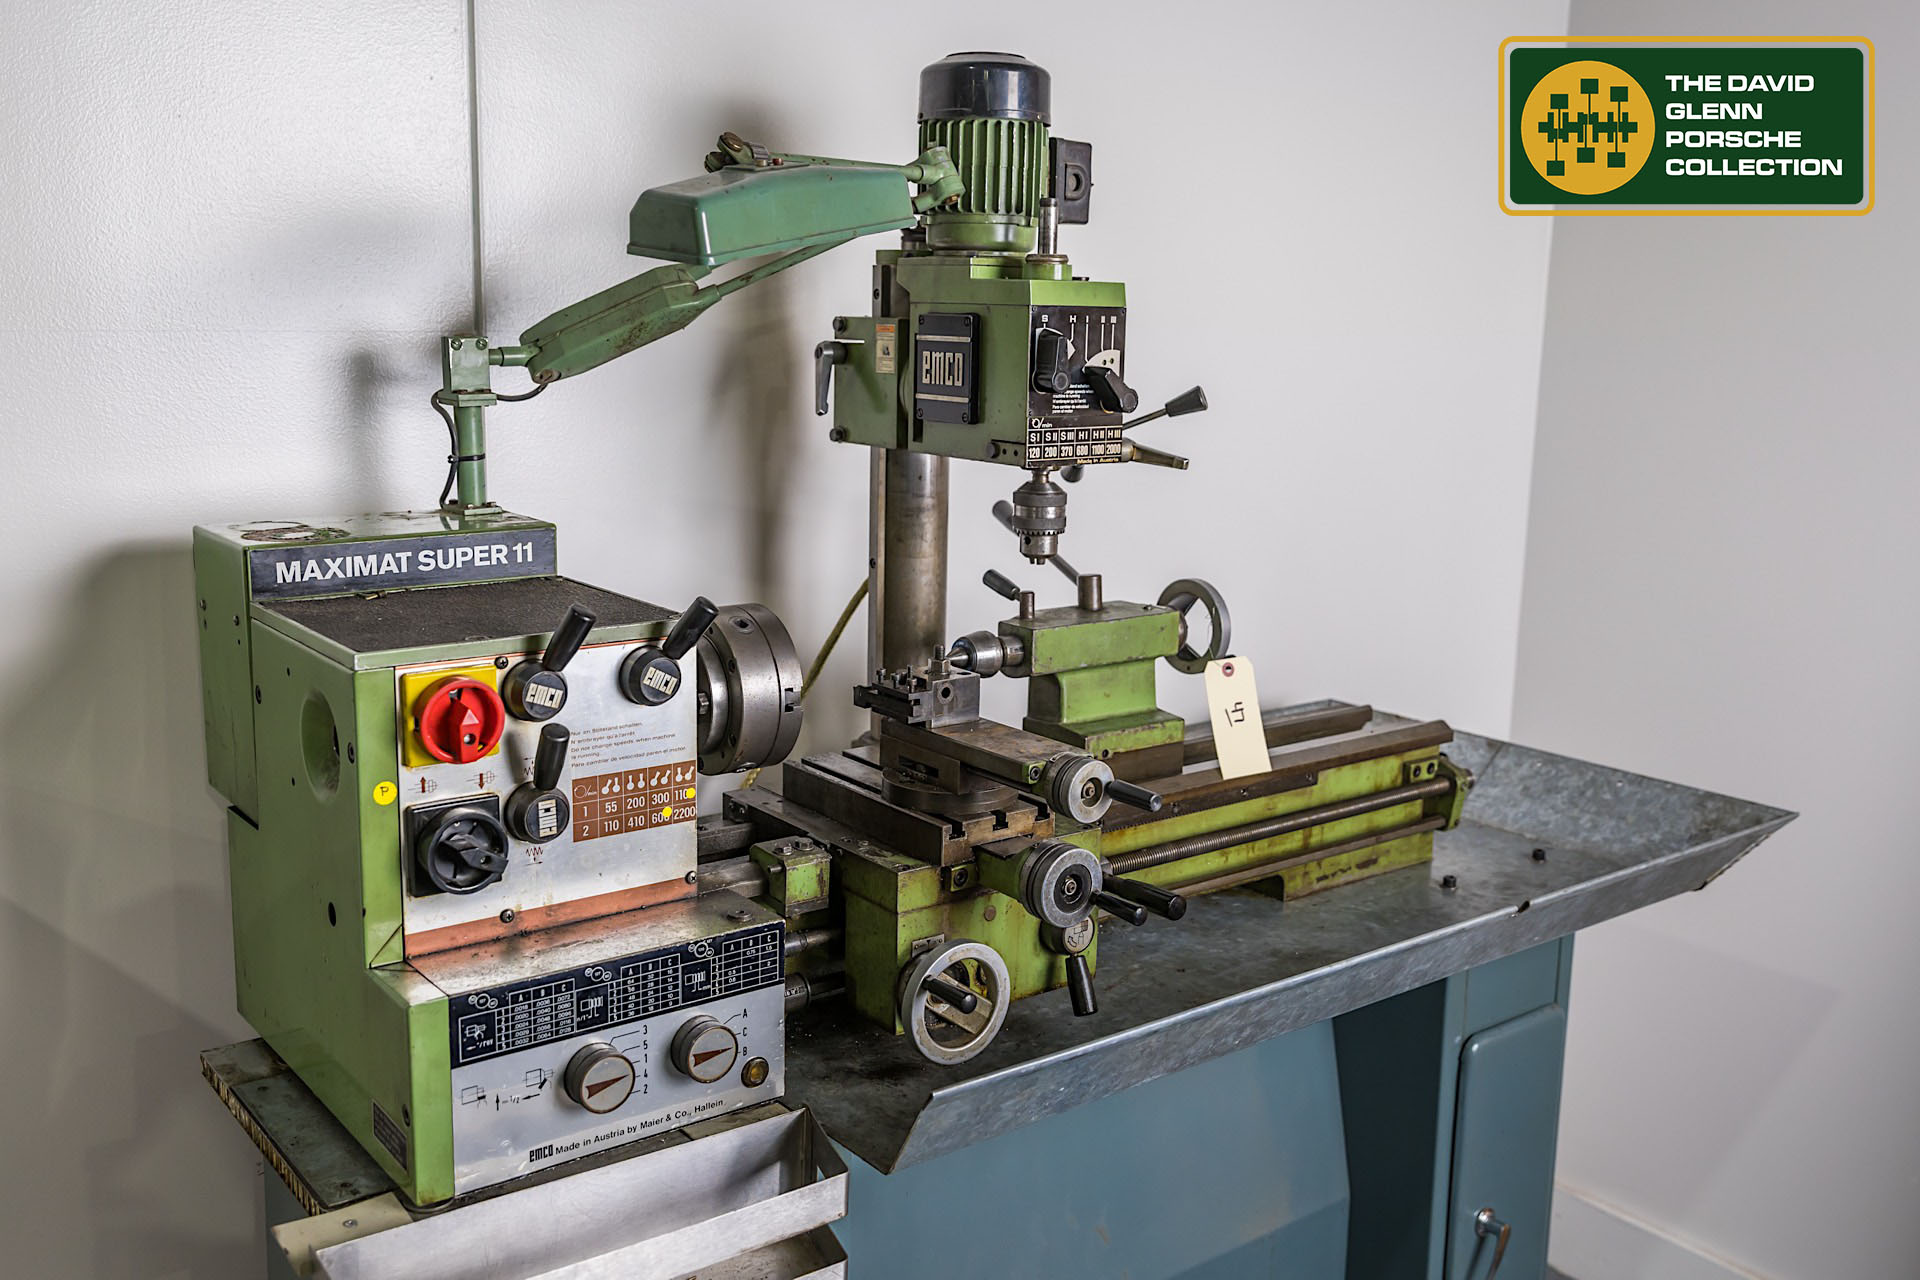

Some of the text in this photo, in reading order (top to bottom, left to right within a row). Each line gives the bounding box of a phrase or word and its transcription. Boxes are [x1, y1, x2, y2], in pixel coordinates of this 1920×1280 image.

[1042, 314, 1048, 322] S
[1070, 315, 1076, 323] H
[922, 350, 964, 387] emco
[1029, 448, 1040, 458] 120
[1044, 446, 1057, 457] 200
[1061, 446, 1073, 456] 370
[276, 542, 533, 584] MAXIMAT SUPER 11
[642, 666, 678, 695] emco
[525, 682, 564, 709] emco
[380, 786, 389, 796] P
[583, 806, 588, 817] 1
[605, 801, 617, 813] 55
[627, 796, 645, 809] 200
[652, 792, 670, 804] 300
[583, 826, 589, 837] 2
[604, 820, 619, 832] 110
[628, 816, 645, 827] 410
[674, 806, 696, 820] 2200
[519, 994, 523, 1002] A
[743, 1008, 748, 1018] A
[643, 1025, 648, 1035] 3
[743, 1027, 748, 1036] C
[643, 1040, 648, 1050] 5
[743, 1047, 748, 1056] B
[644, 1053, 647, 1063] 1
[644, 1084, 648, 1094] 2
[529, 1144, 553, 1162] emco
[556, 1142, 580, 1155] Made
[583, 1138, 591, 1146] in
[594, 1129, 625, 1143] Austria
[627, 1124, 637, 1134] by
[640, 1117, 664, 1129] Maier
[666, 1114, 672, 1122] &
